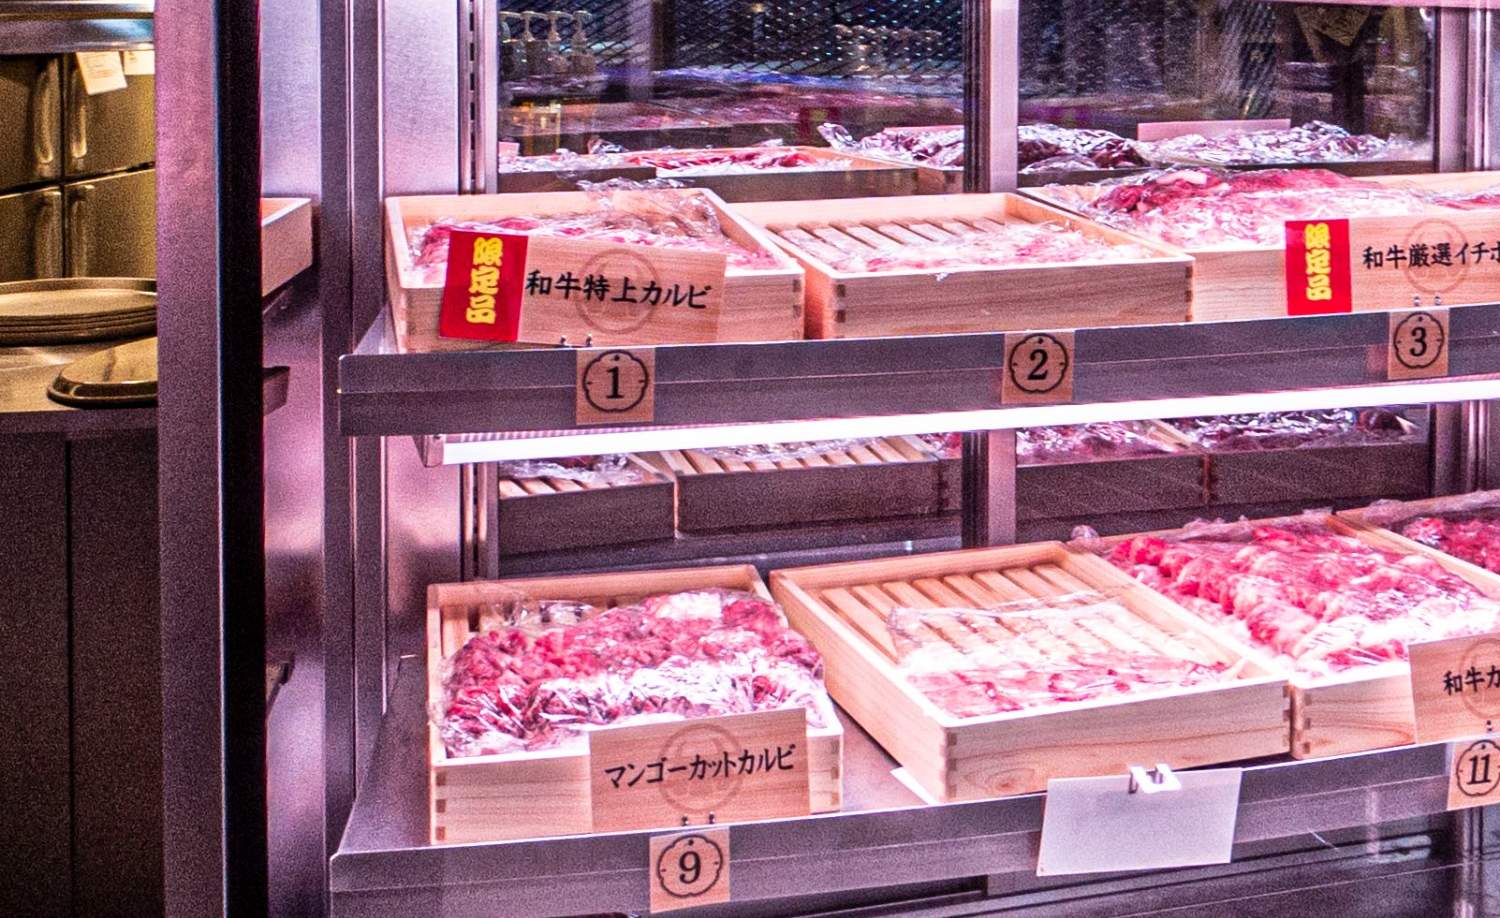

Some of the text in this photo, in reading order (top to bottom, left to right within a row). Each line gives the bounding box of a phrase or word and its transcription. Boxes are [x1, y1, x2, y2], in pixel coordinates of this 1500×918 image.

[1304, 222, 1332, 301] 限定品
[465, 237, 503, 324] 限定品
[525, 269, 712, 309] 和牛特上カルビ
[1409, 326, 1428, 357] 3
[1027, 348, 1049, 381] 2
[605, 366, 625, 399] 1
[604, 743, 796, 788] マンゴーカットカルビ
[1466, 754, 1492, 785] 11
[678, 850, 702, 885] 9
